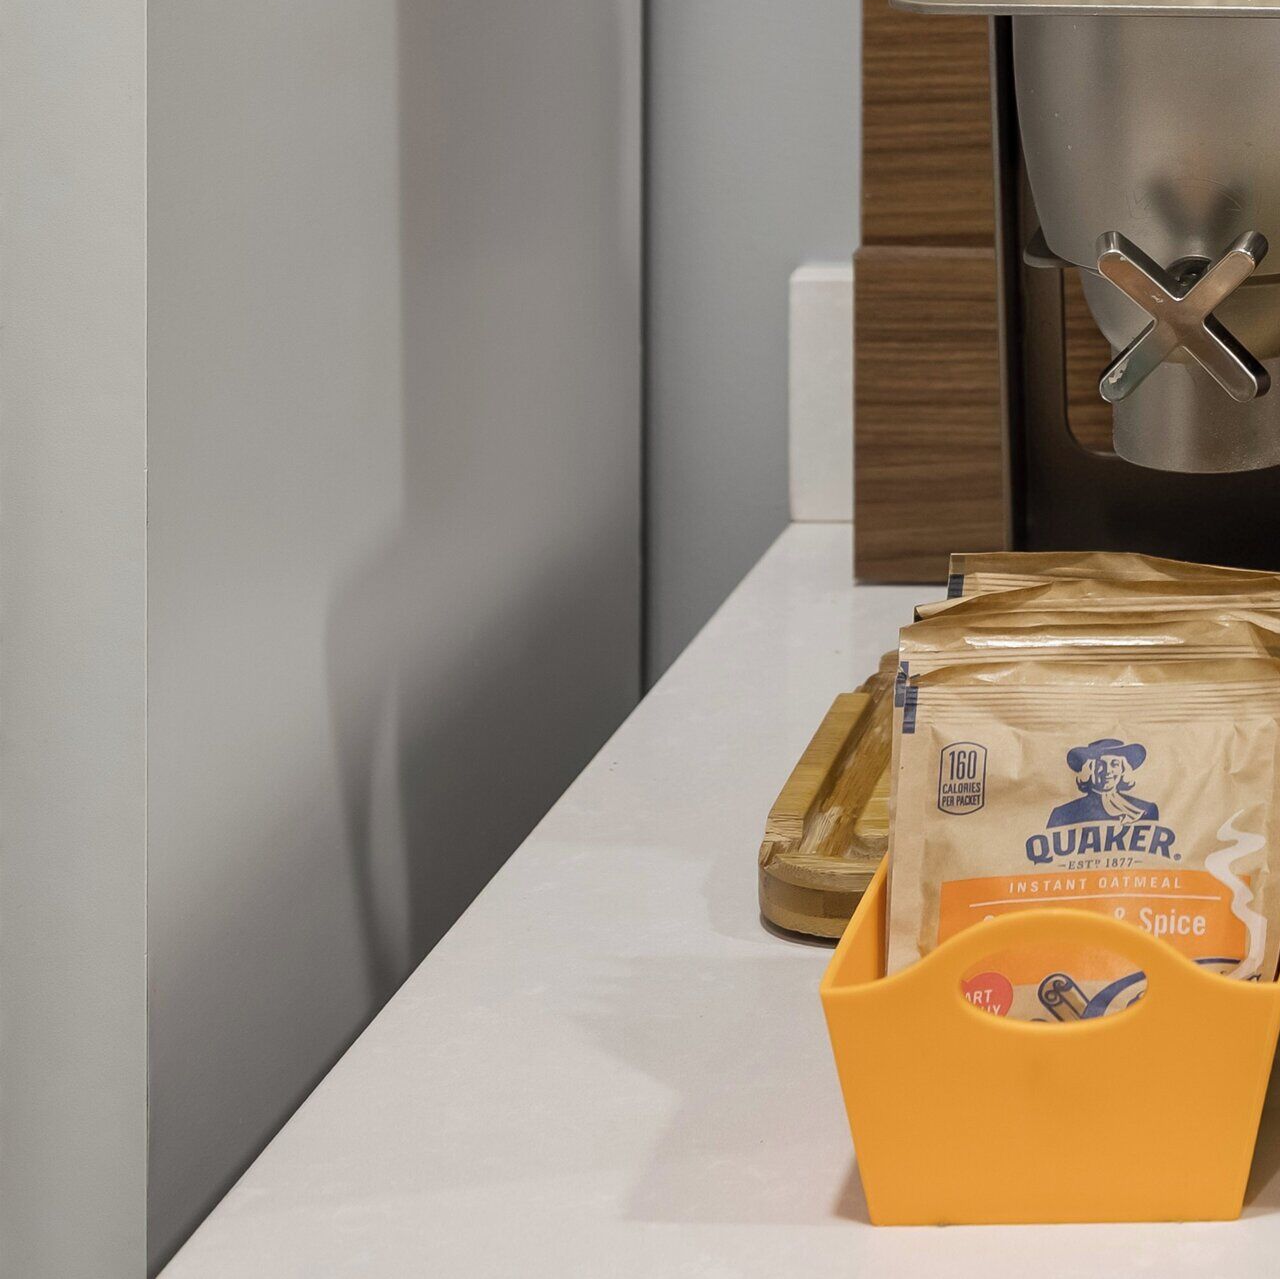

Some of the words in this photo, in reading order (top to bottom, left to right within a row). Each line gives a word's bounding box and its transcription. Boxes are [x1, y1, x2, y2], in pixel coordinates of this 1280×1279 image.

[949, 750, 978, 780] 160
[942, 782, 981, 794] CALORIES
[941, 795, 955, 807] PER
[956, 794, 981, 807] PACKET
[1025, 825, 1176, 865] QUAKER
[1105, 857, 1134, 868] 1877
[1009, 878, 1089, 894] INSTANT
[1099, 876, 1181, 890] OATMEAL
[1138, 907, 1206, 937] Spice
[964, 989, 993, 1004] ART
